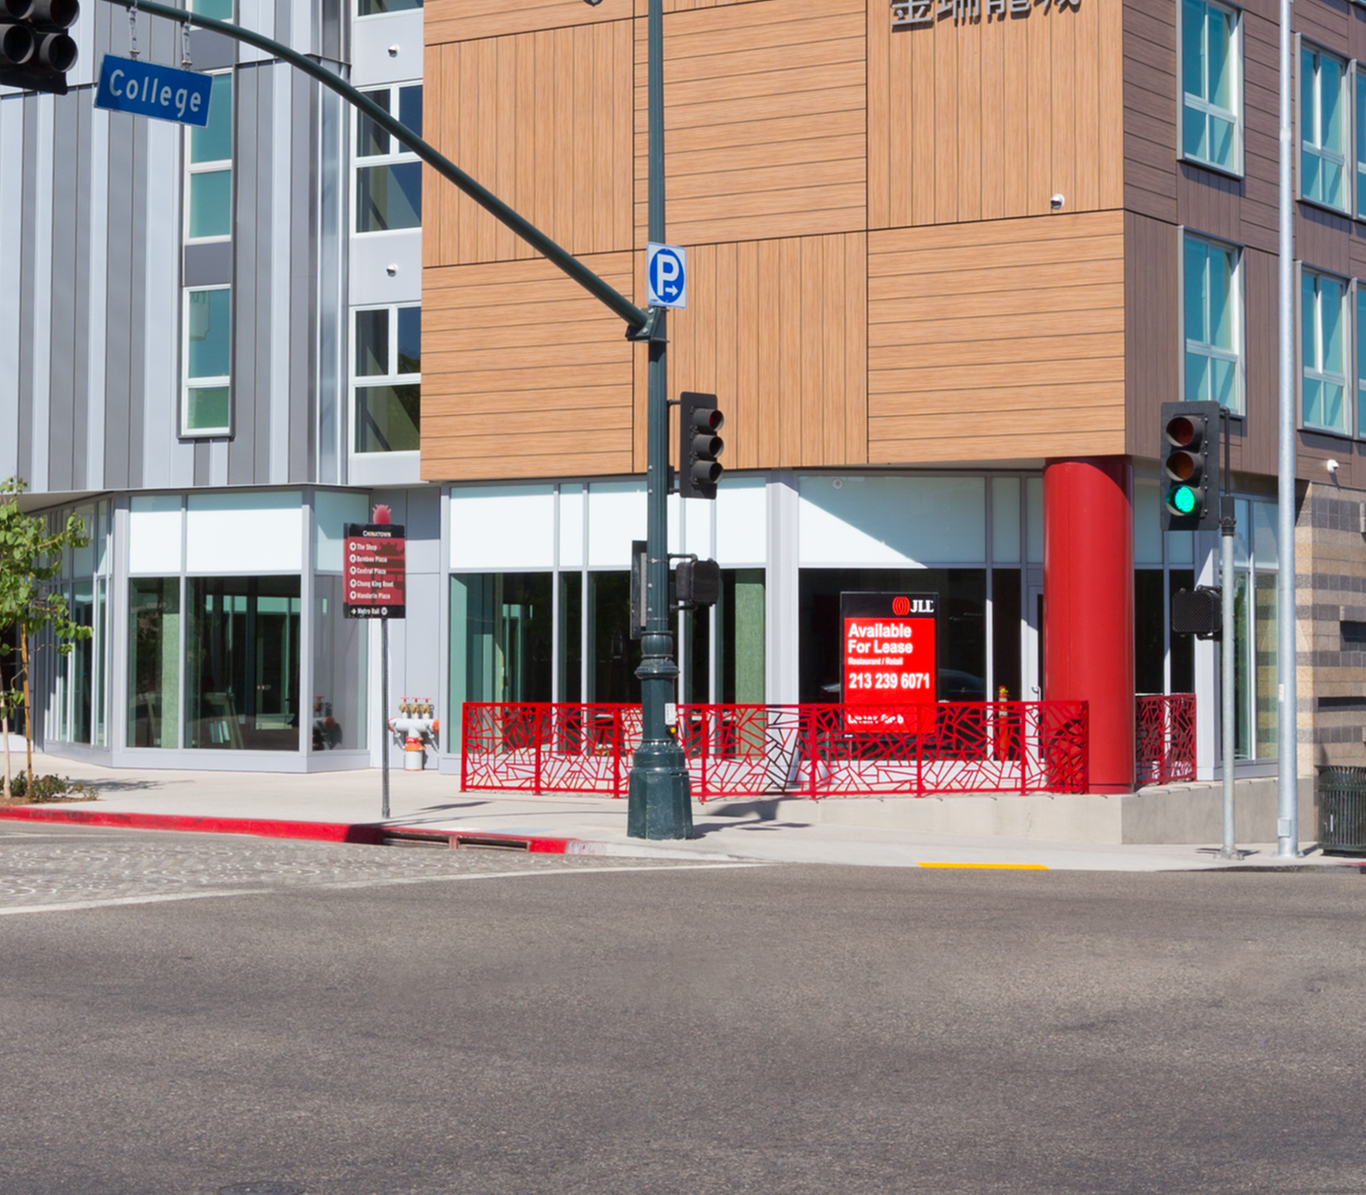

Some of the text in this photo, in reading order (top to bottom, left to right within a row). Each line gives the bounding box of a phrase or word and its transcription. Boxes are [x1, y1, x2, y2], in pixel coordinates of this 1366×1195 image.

[109, 69, 201, 118] College
[657, 254, 680, 297] P
[910, 600, 934, 613] JLL
[848, 623, 912, 638] Available
[848, 639, 913, 653] For Lease
[848, 657, 881, 665] Restaurant
[885, 657, 903, 665] Retail
[848, 673, 930, 689] 213 239 6071
